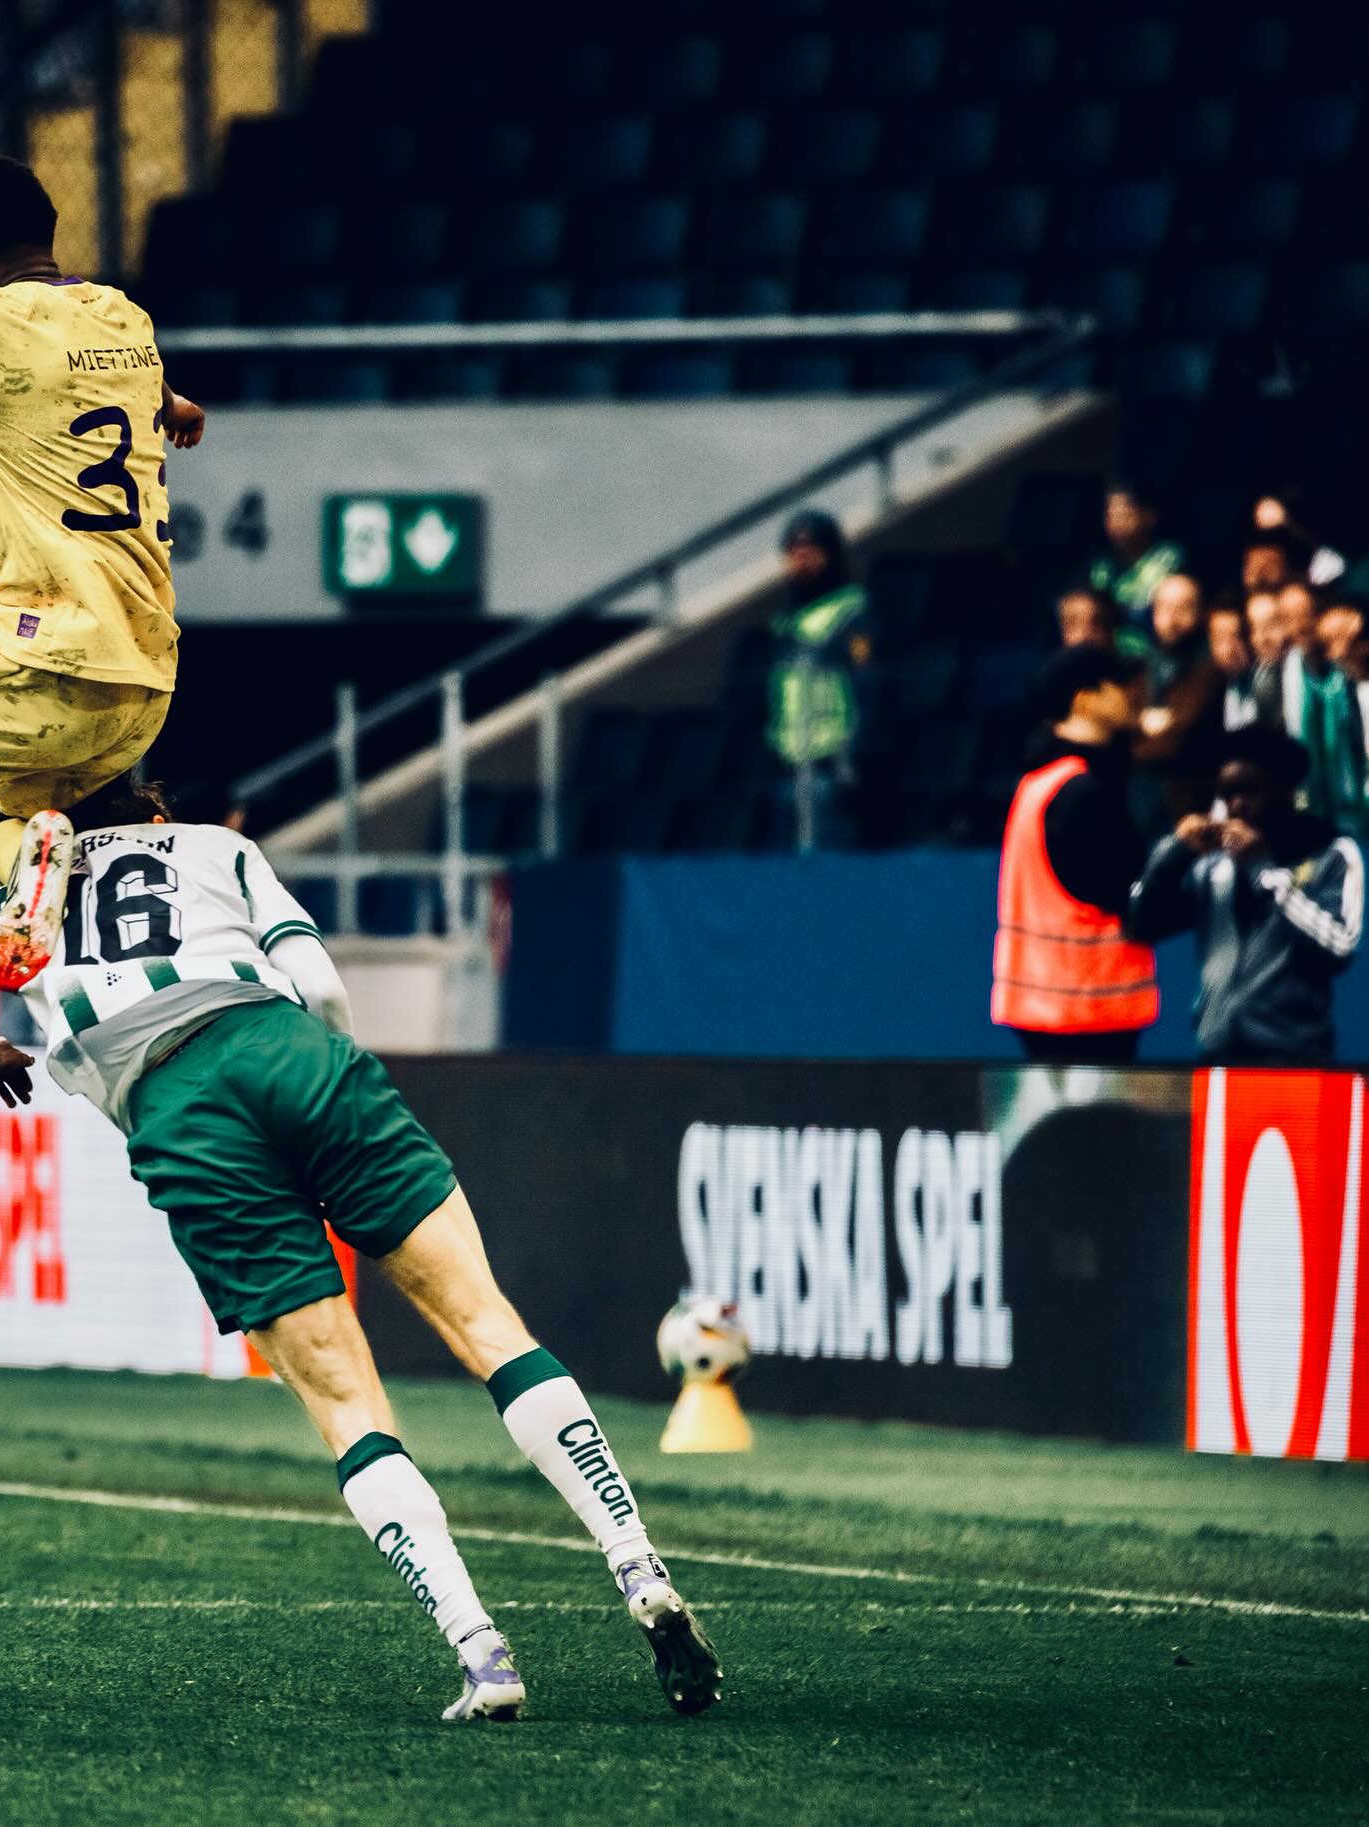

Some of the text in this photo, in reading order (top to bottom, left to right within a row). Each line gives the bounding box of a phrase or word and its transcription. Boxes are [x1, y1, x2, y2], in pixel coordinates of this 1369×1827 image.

[61, 405, 169, 542] 3
[63, 852, 183, 966] 16
[894, 1126, 1014, 1369] SPEL
[374, 1521, 437, 1616] Clinton
